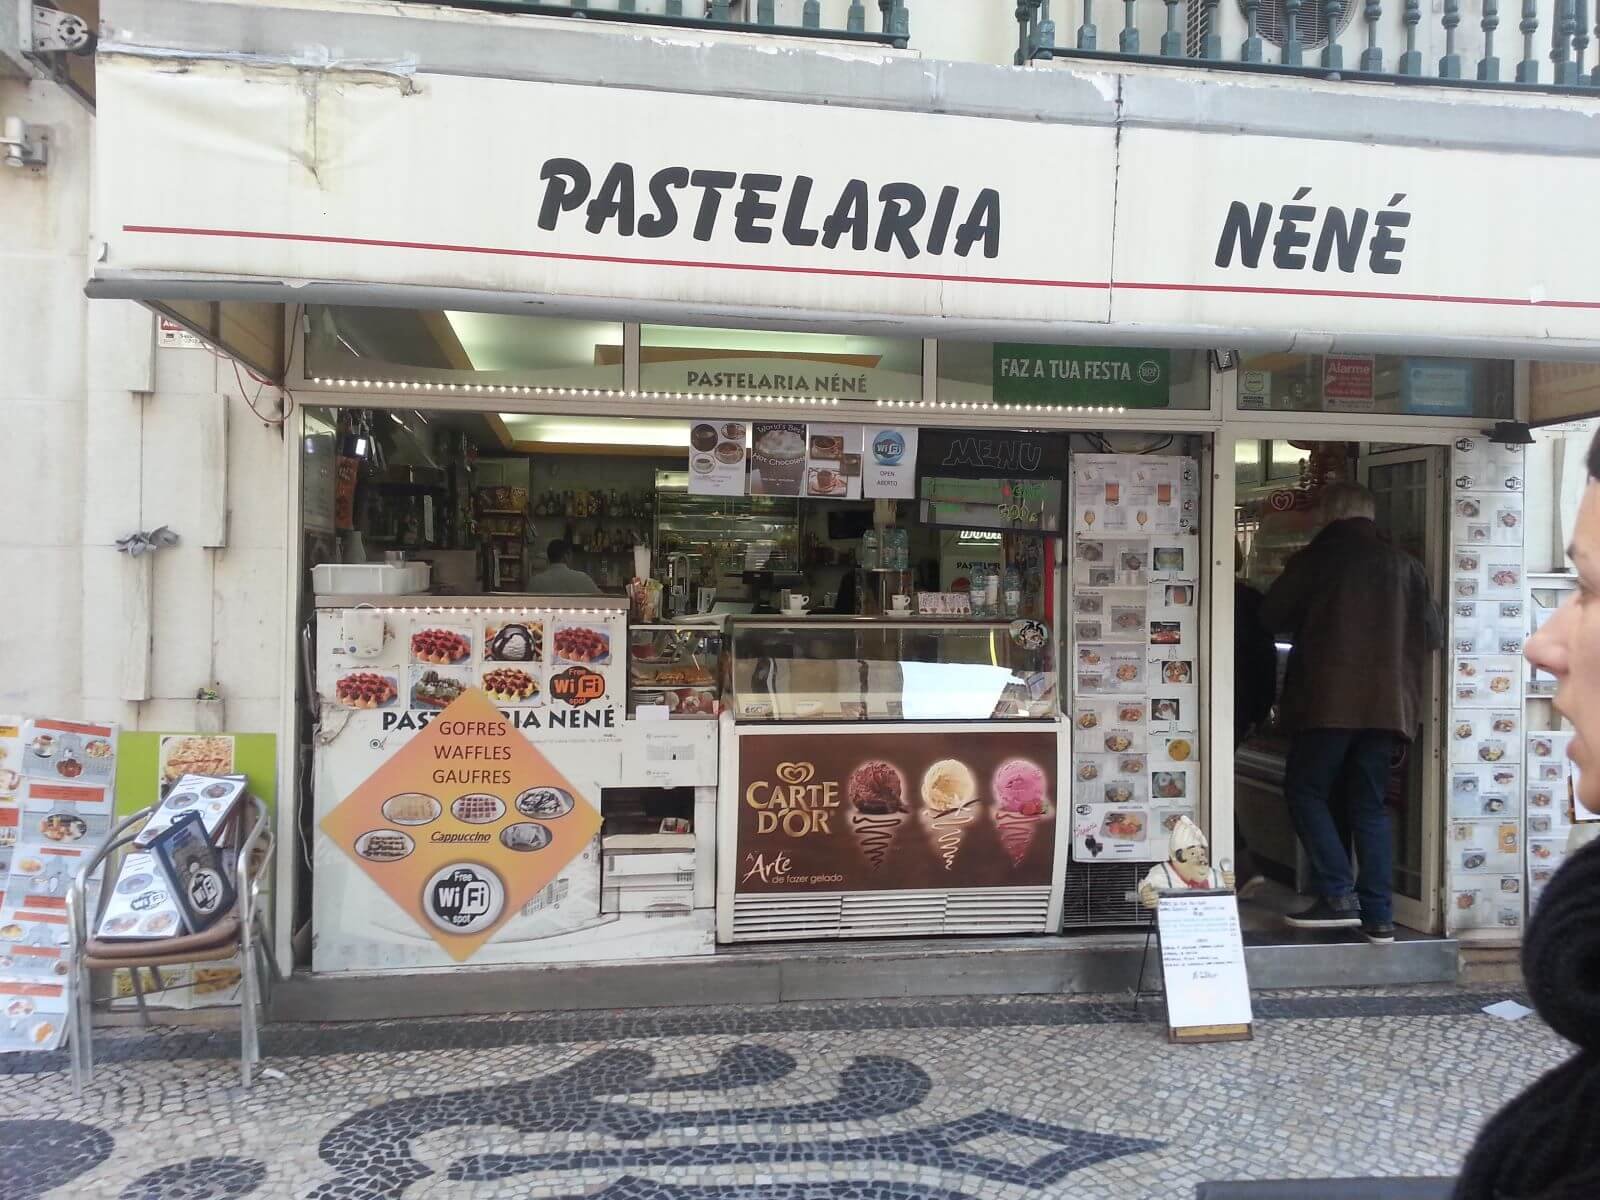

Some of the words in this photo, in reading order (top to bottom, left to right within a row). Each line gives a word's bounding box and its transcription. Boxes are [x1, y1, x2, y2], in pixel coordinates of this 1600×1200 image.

[537, 157, 1001, 260] PASTELARIA
[1214, 186, 1412, 275] NÉNÉ
[1001, 358, 1029, 378] FAZ
[1034, 360, 1044, 378] A
[1049, 359, 1081, 379] TUA
[1084, 361, 1132, 381] FESTA
[1327, 362, 1370, 374] Alarme
[687, 371, 810, 391] PASTELARIA
[814, 373, 867, 393] NÉNÉ
[942, 438, 1041, 471] MENU
[439, 721, 507, 736] GOFRES
[434, 745, 512, 760] WAFFLES
[432, 769, 512, 784] GAUFRES
[746, 781, 841, 812] CARTE
[757, 808, 832, 838] D'OR
[431, 831, 492, 844] Cappuccino
[742, 851, 793, 884] Arte
[454, 871, 473, 882] Free
[771, 875, 785, 884] de
[787, 874, 809, 883] fazer
[810, 873, 843, 885] gelado
[452, 914, 471, 925] spot
